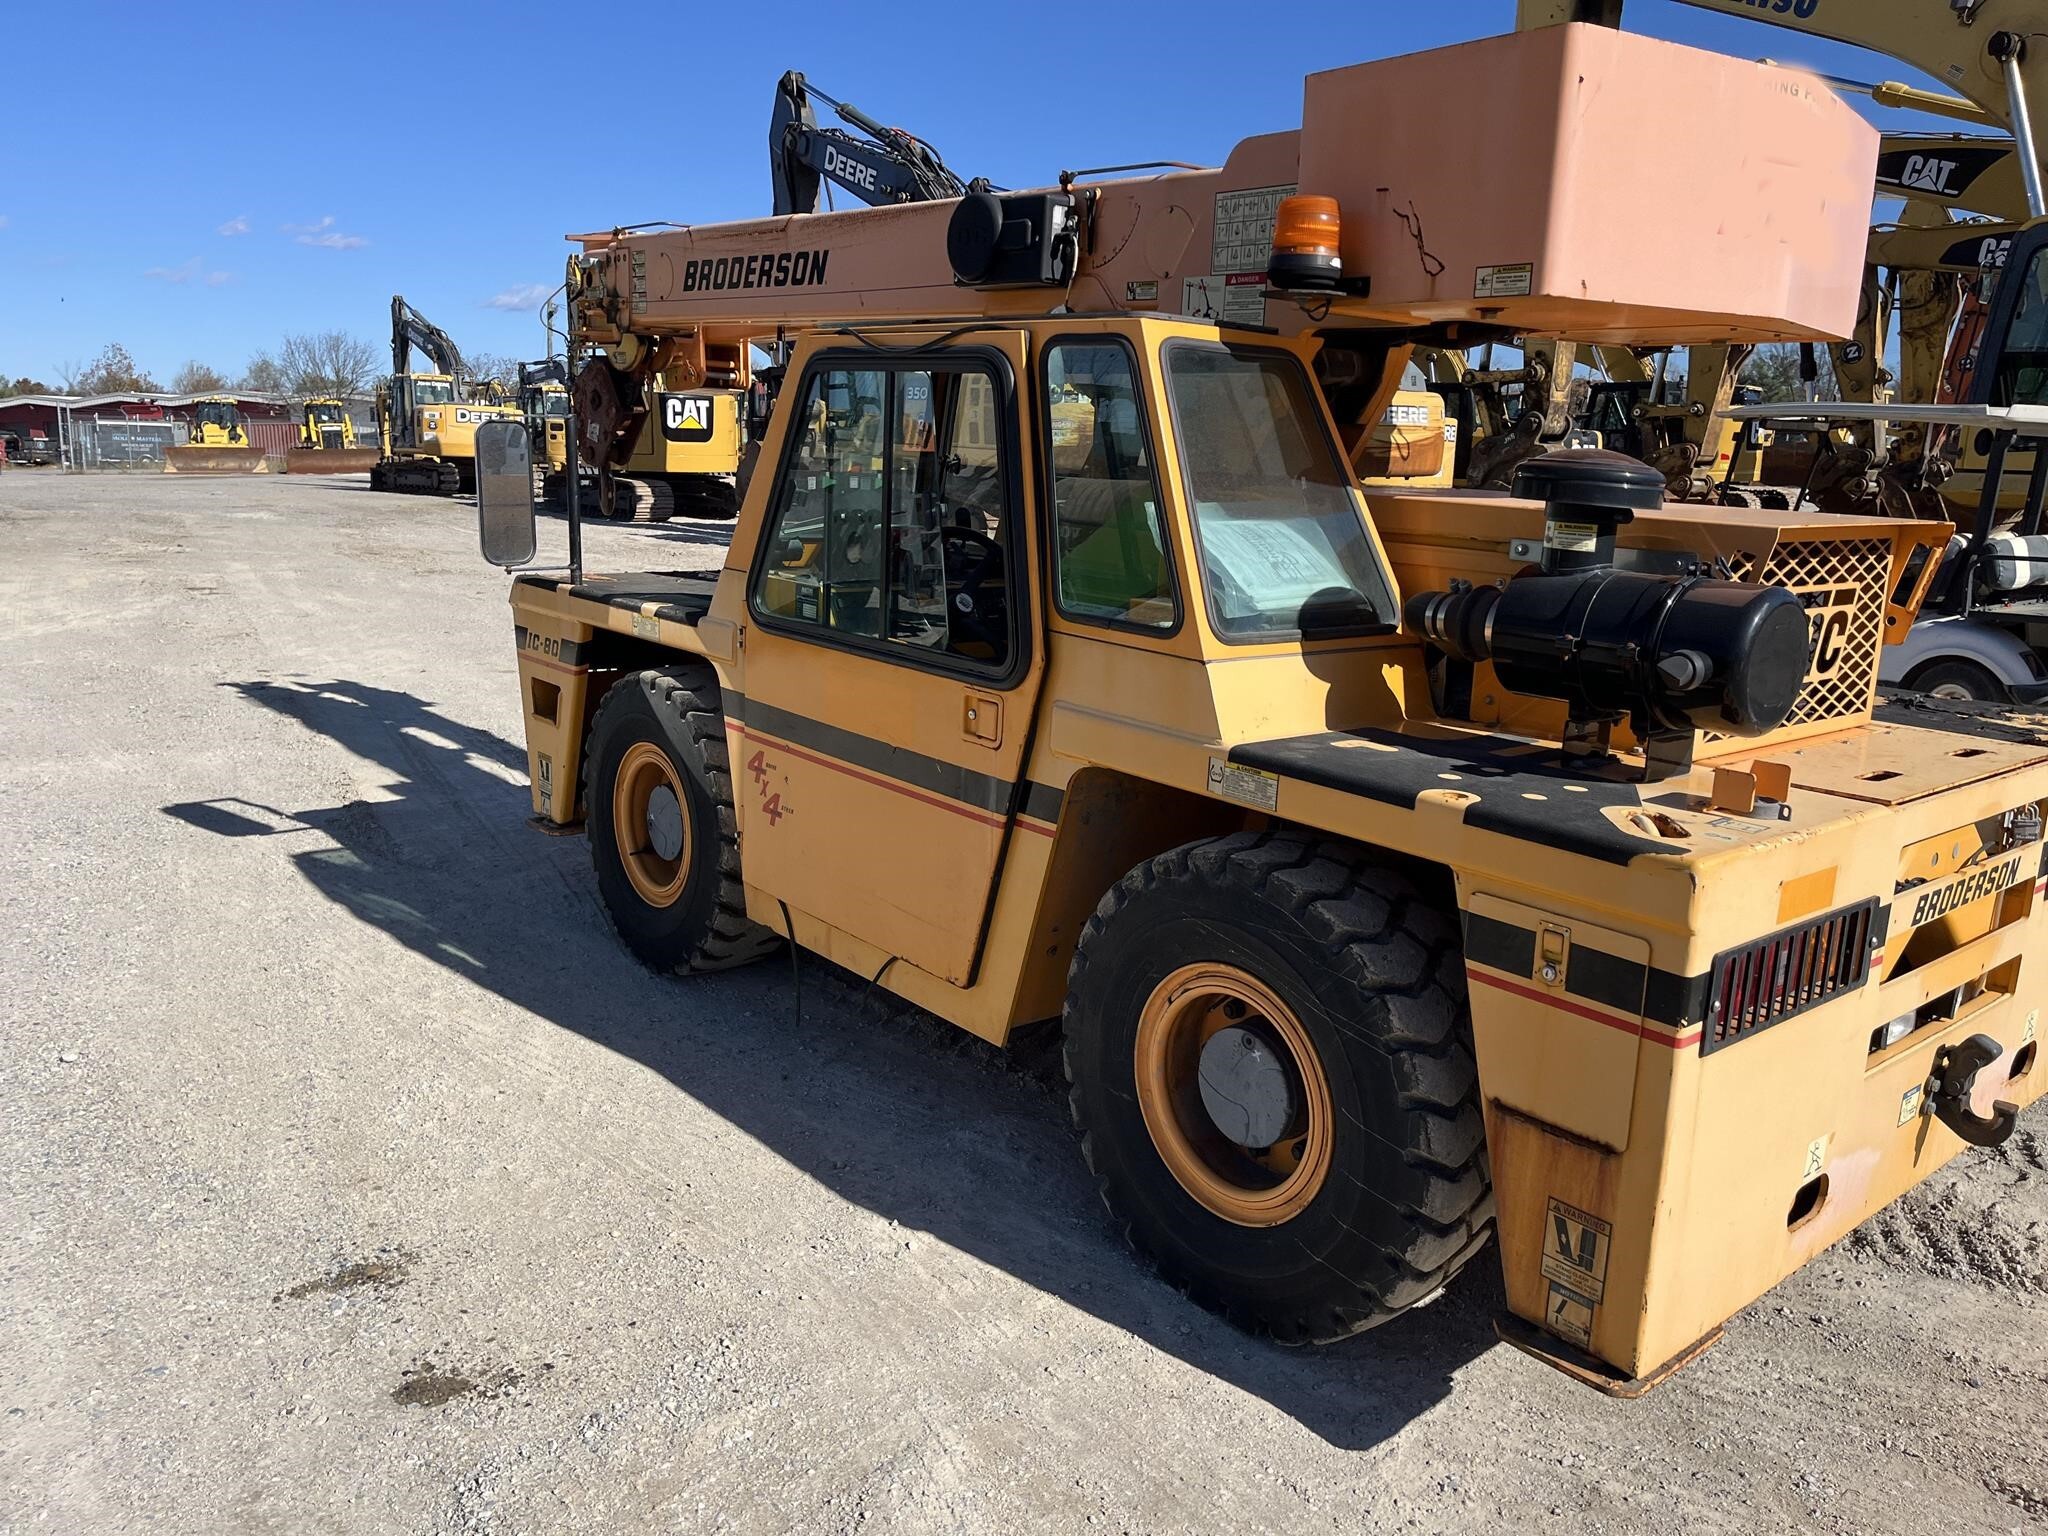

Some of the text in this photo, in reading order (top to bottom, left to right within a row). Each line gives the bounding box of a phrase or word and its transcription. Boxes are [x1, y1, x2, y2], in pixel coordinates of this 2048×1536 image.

[824, 144, 877, 191] DEERE
[1901, 155, 1956, 192] CAT
[1978, 238, 2011, 266] CA
[683, 250, 829, 291] BRODERSON
[907, 386, 928, 399] 350
[456, 408, 511, 423] DEE
[666, 398, 709, 429] CAT
[747, 750, 767, 784] 4
[762, 793, 783, 827] 4
[1911, 856, 2022, 927] BRODERSON
[1563, 1206, 1606, 1232] WARNING
